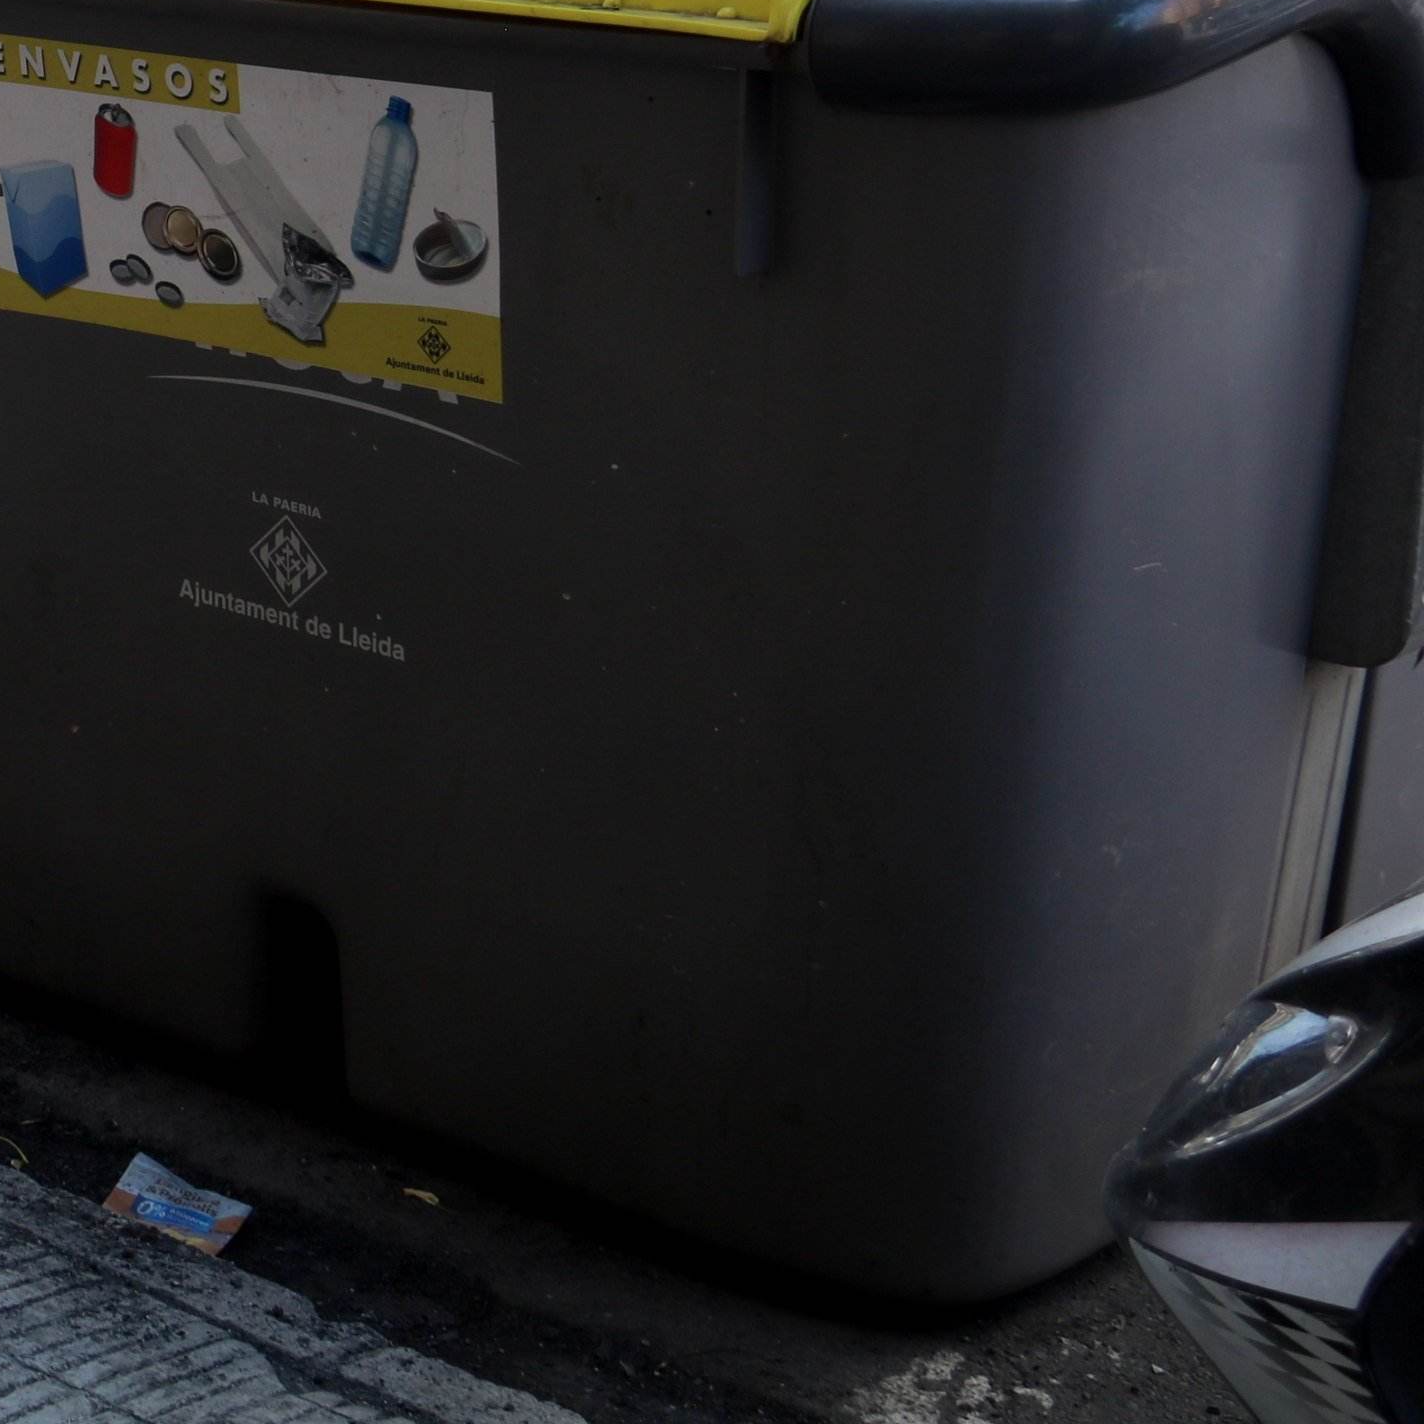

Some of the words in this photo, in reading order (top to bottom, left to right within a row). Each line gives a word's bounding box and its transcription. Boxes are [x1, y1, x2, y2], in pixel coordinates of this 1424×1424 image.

[385, 356, 441, 377] Ajuntament
[442, 367, 454, 379] de
[456, 369, 486, 385] Lleida
[251, 491, 269, 506] LA
[272, 496, 322, 520] PAERIA
[178, 578, 301, 635] Ajuntament
[304, 612, 333, 640] de
[338, 620, 407, 662] Lleida
